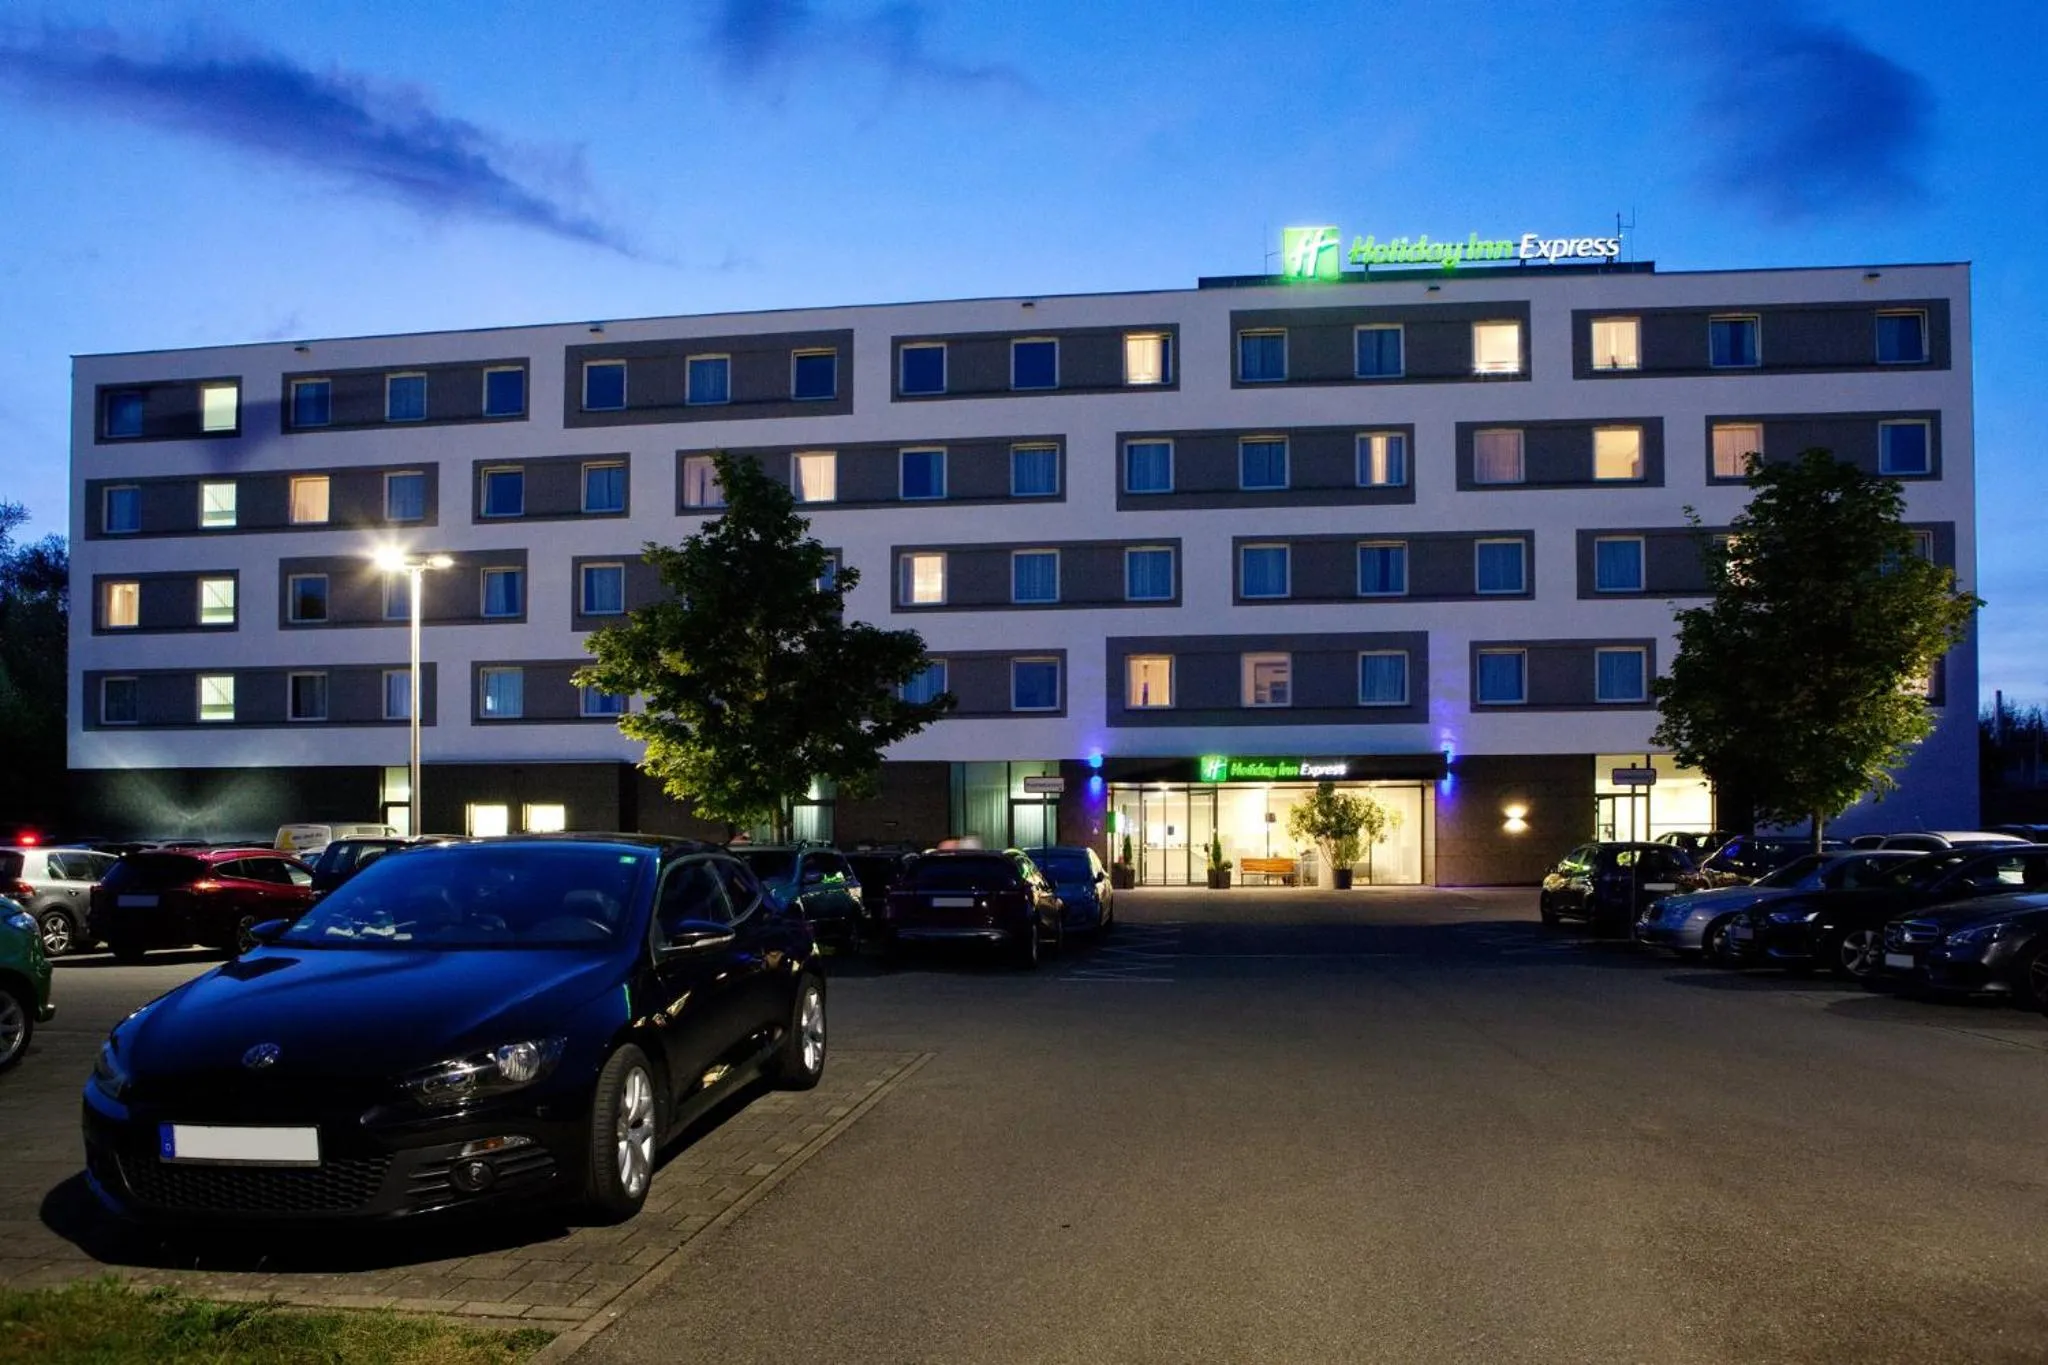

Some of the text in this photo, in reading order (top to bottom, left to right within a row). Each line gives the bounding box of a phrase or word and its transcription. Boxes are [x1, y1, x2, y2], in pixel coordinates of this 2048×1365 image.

[1349, 231, 1619, 267] Holiday Inn Express
[1230, 761, 1347, 778] Holiday Inn Express
